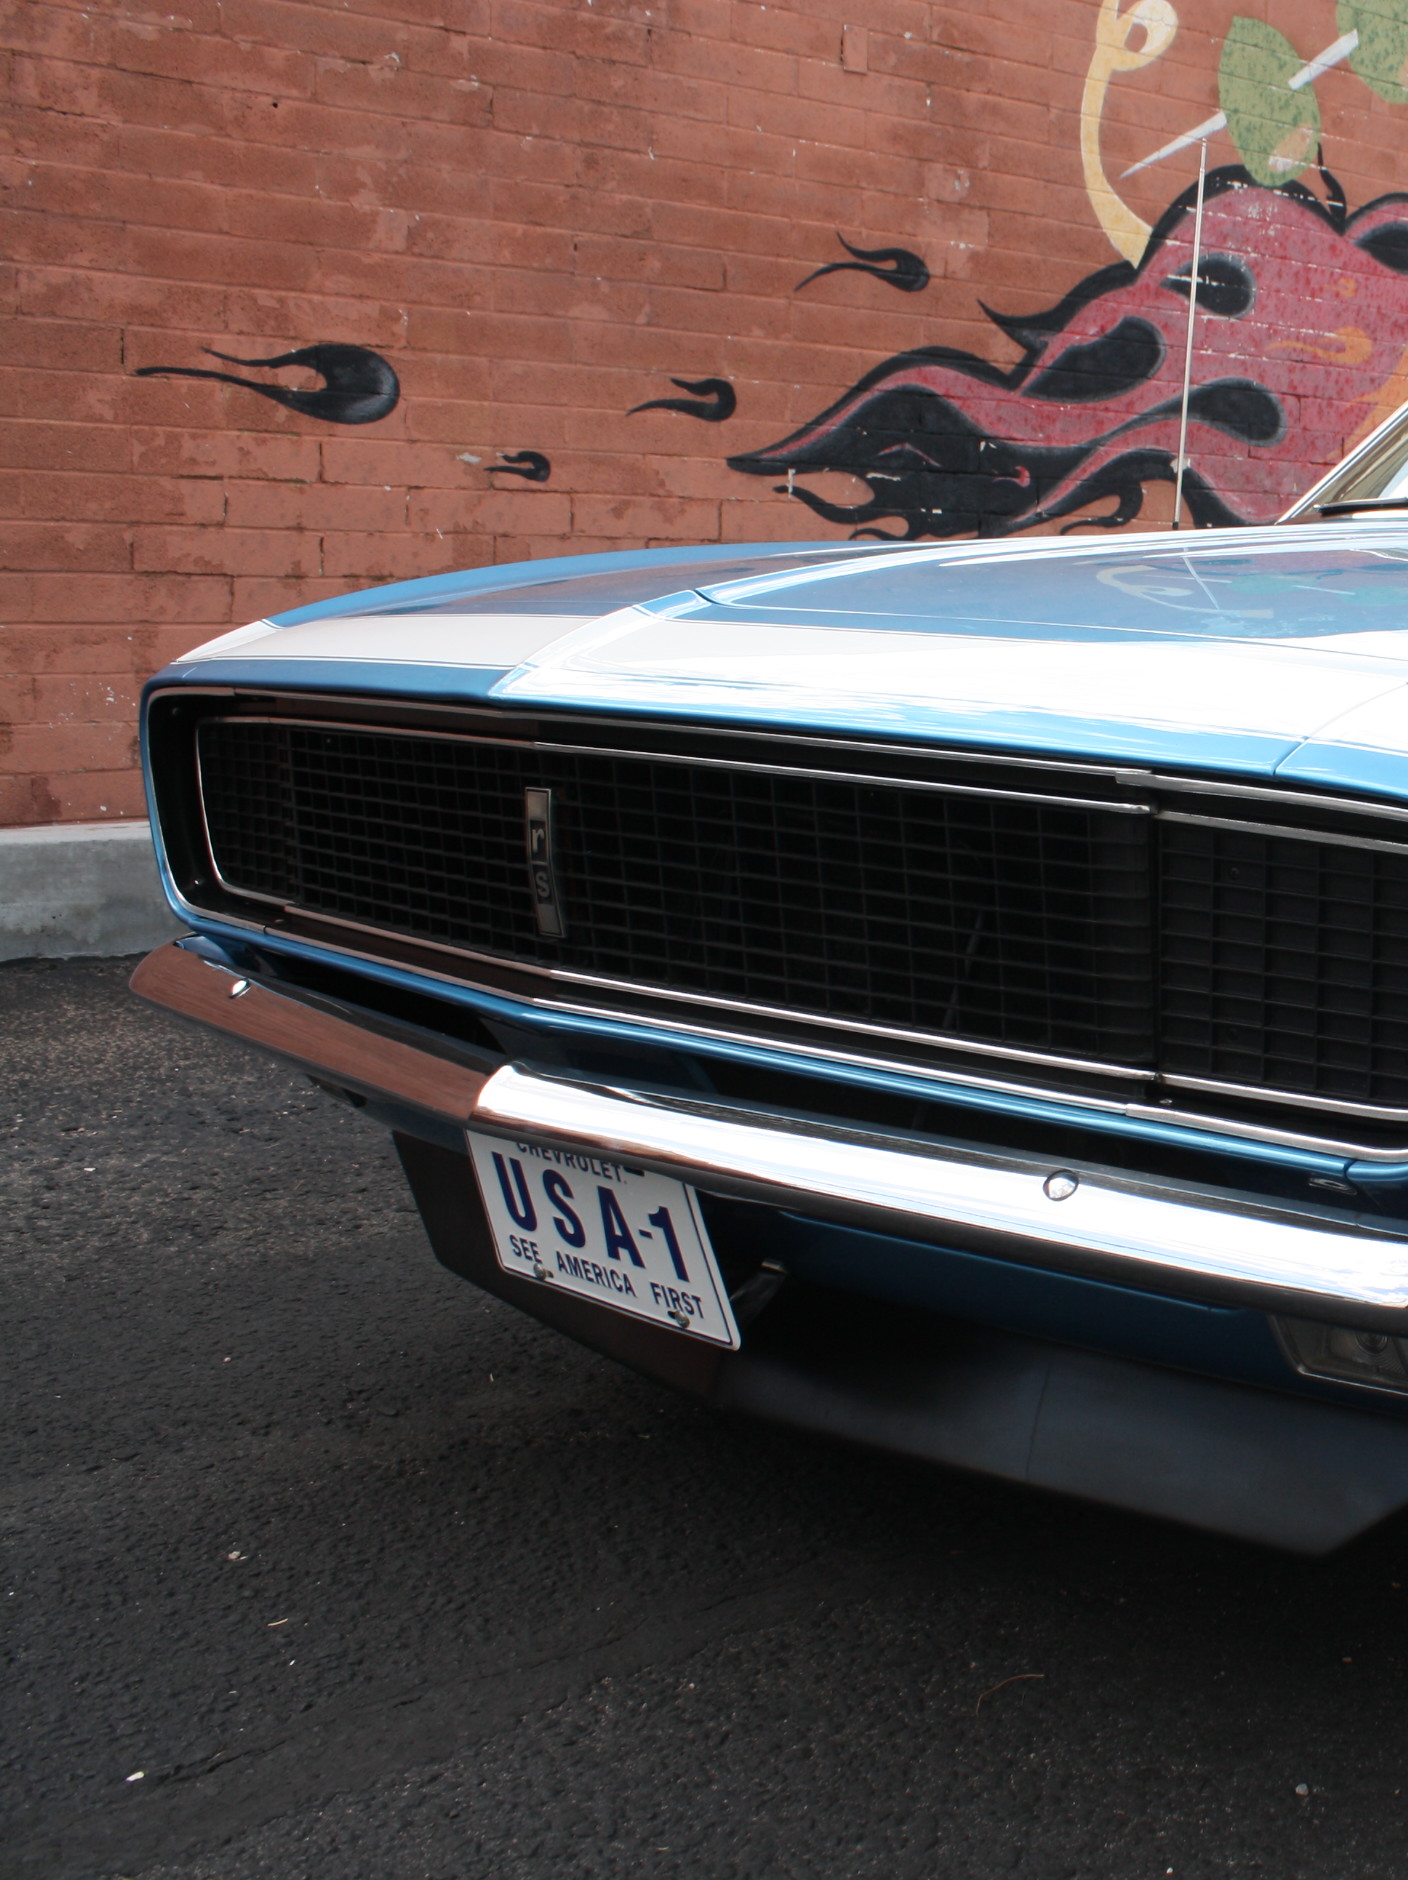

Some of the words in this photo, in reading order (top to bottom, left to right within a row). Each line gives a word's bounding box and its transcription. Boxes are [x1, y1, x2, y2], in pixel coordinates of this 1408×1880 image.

[516, 1141, 622, 1183] CHEVROLET
[491, 1151, 690, 1283] USA-1
[508, 1234, 543, 1264] SEE
[556, 1251, 638, 1298] AMERICA
[650, 1281, 705, 1320] FIRST
